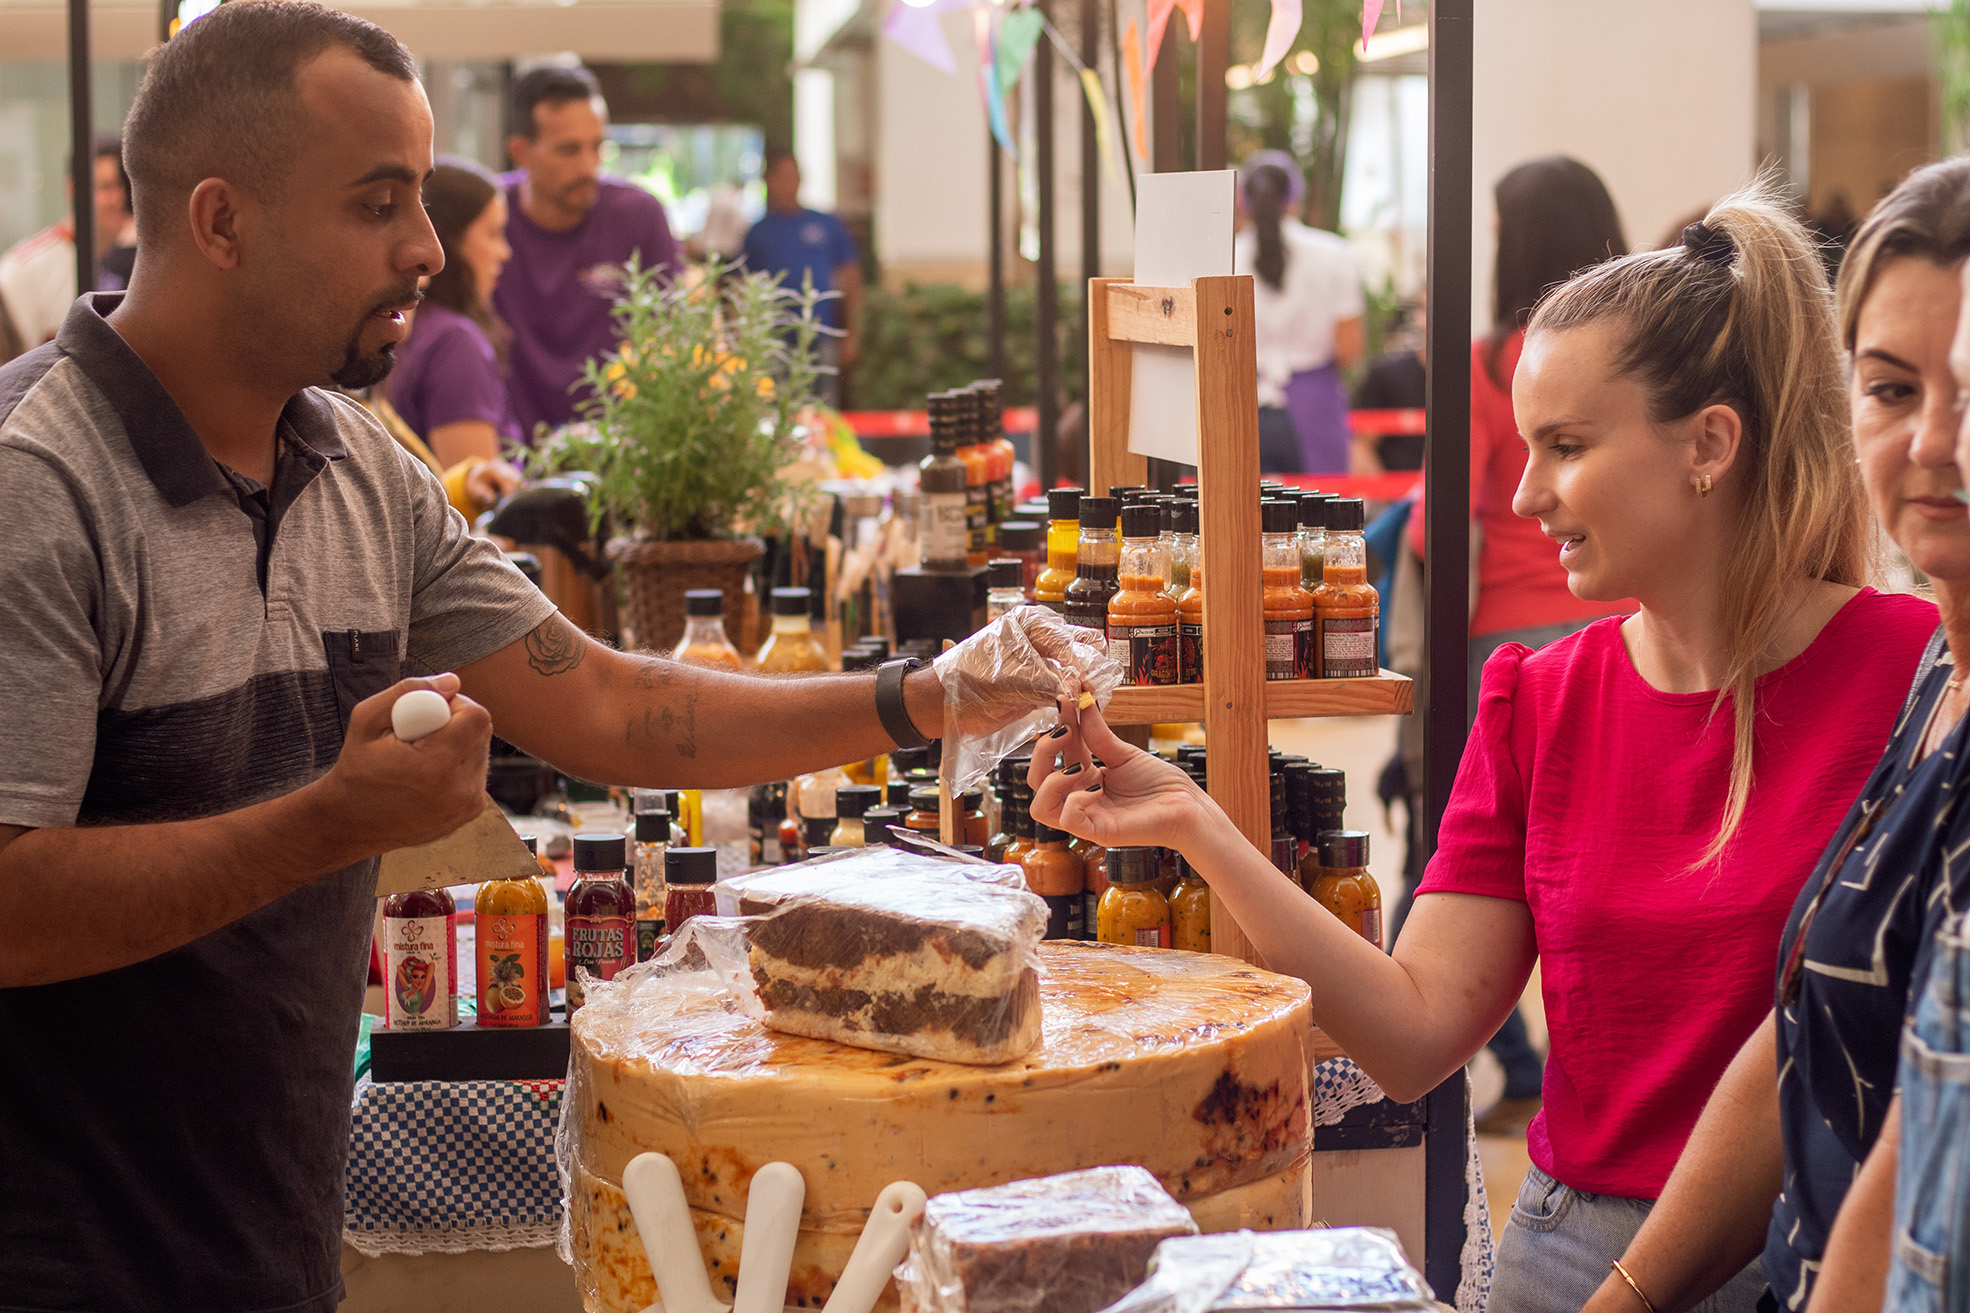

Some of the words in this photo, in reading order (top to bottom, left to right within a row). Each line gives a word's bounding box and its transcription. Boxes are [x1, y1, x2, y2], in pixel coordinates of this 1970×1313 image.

[572, 928, 624, 942] FRUTAS
[394, 942, 418, 951] mistura
[420, 941, 434, 950] fina
[485, 940, 509, 949] mistura
[510, 940, 524, 949] fina
[572, 941, 624, 958] ROJAS
